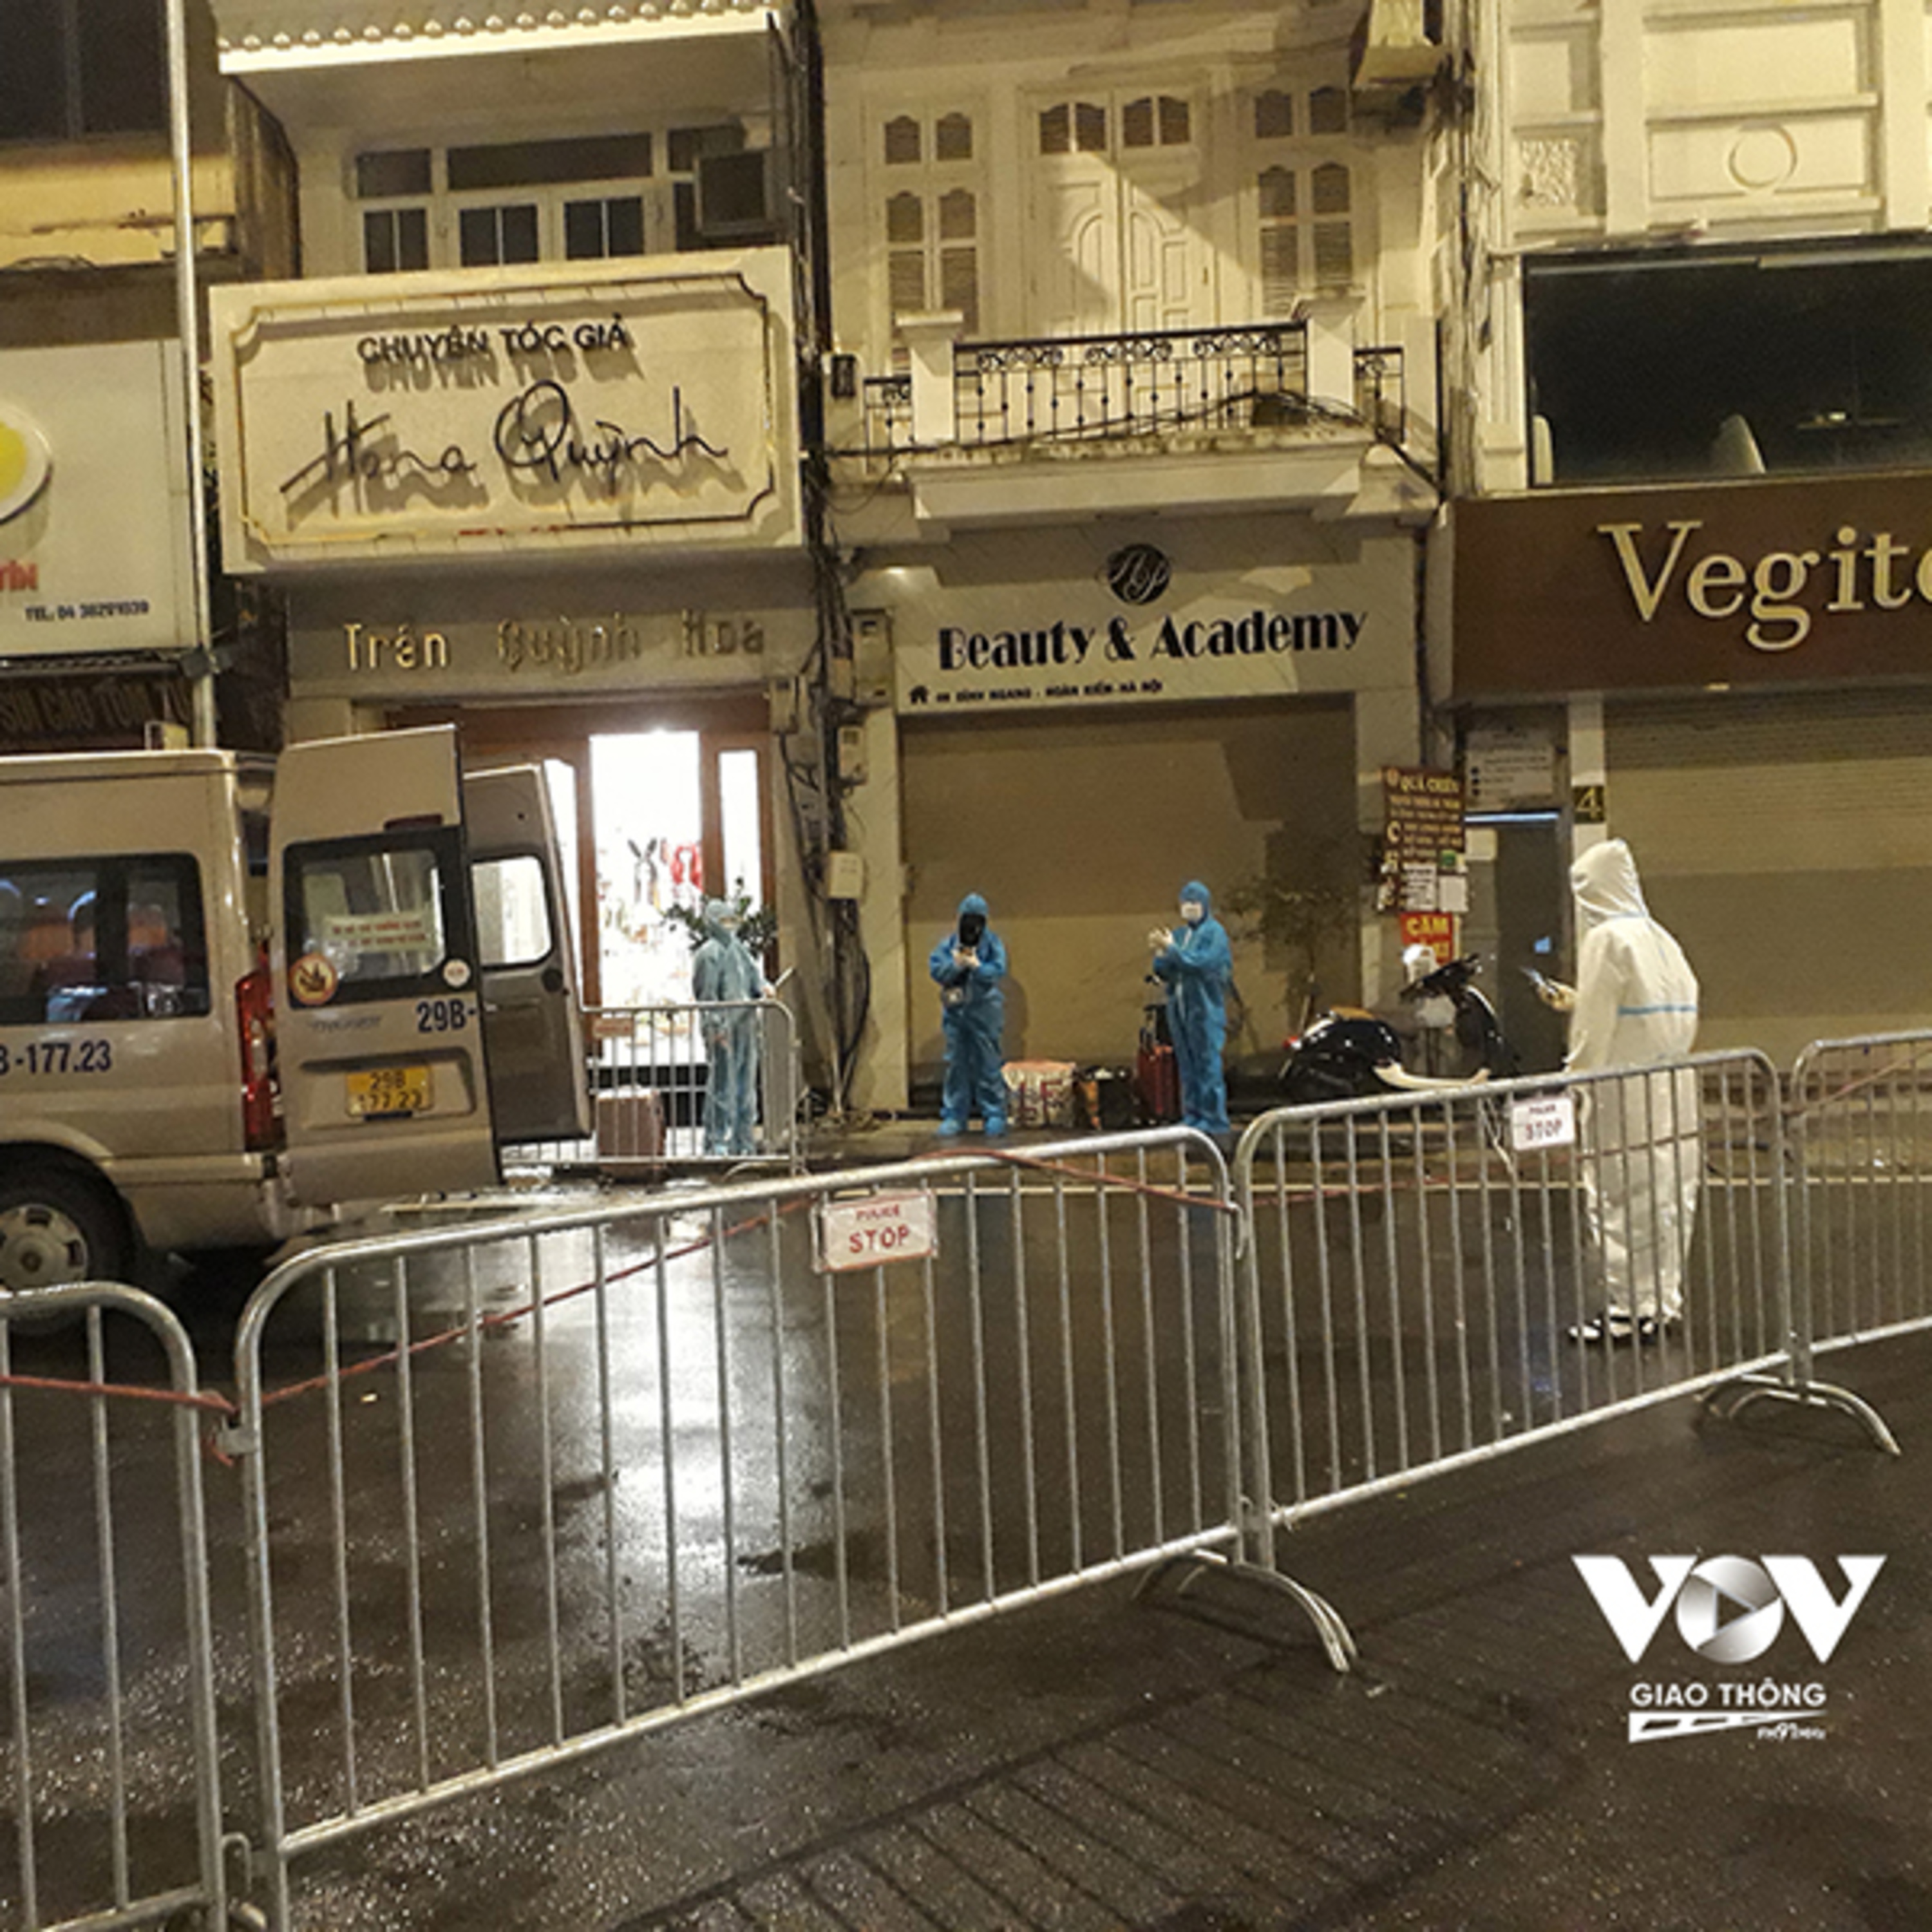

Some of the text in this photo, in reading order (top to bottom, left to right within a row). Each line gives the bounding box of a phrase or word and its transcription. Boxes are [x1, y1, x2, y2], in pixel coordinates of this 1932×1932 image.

[357, 324, 488, 364] CHUYÊN
[499, 320, 566, 355] TÓC
[1597, 520, 1932, 652] Vegit
[939, 611, 1368, 671] Beauty & Academy
[1577, 786, 1601, 819] 4
[849, 1224, 910, 1253] STOP
